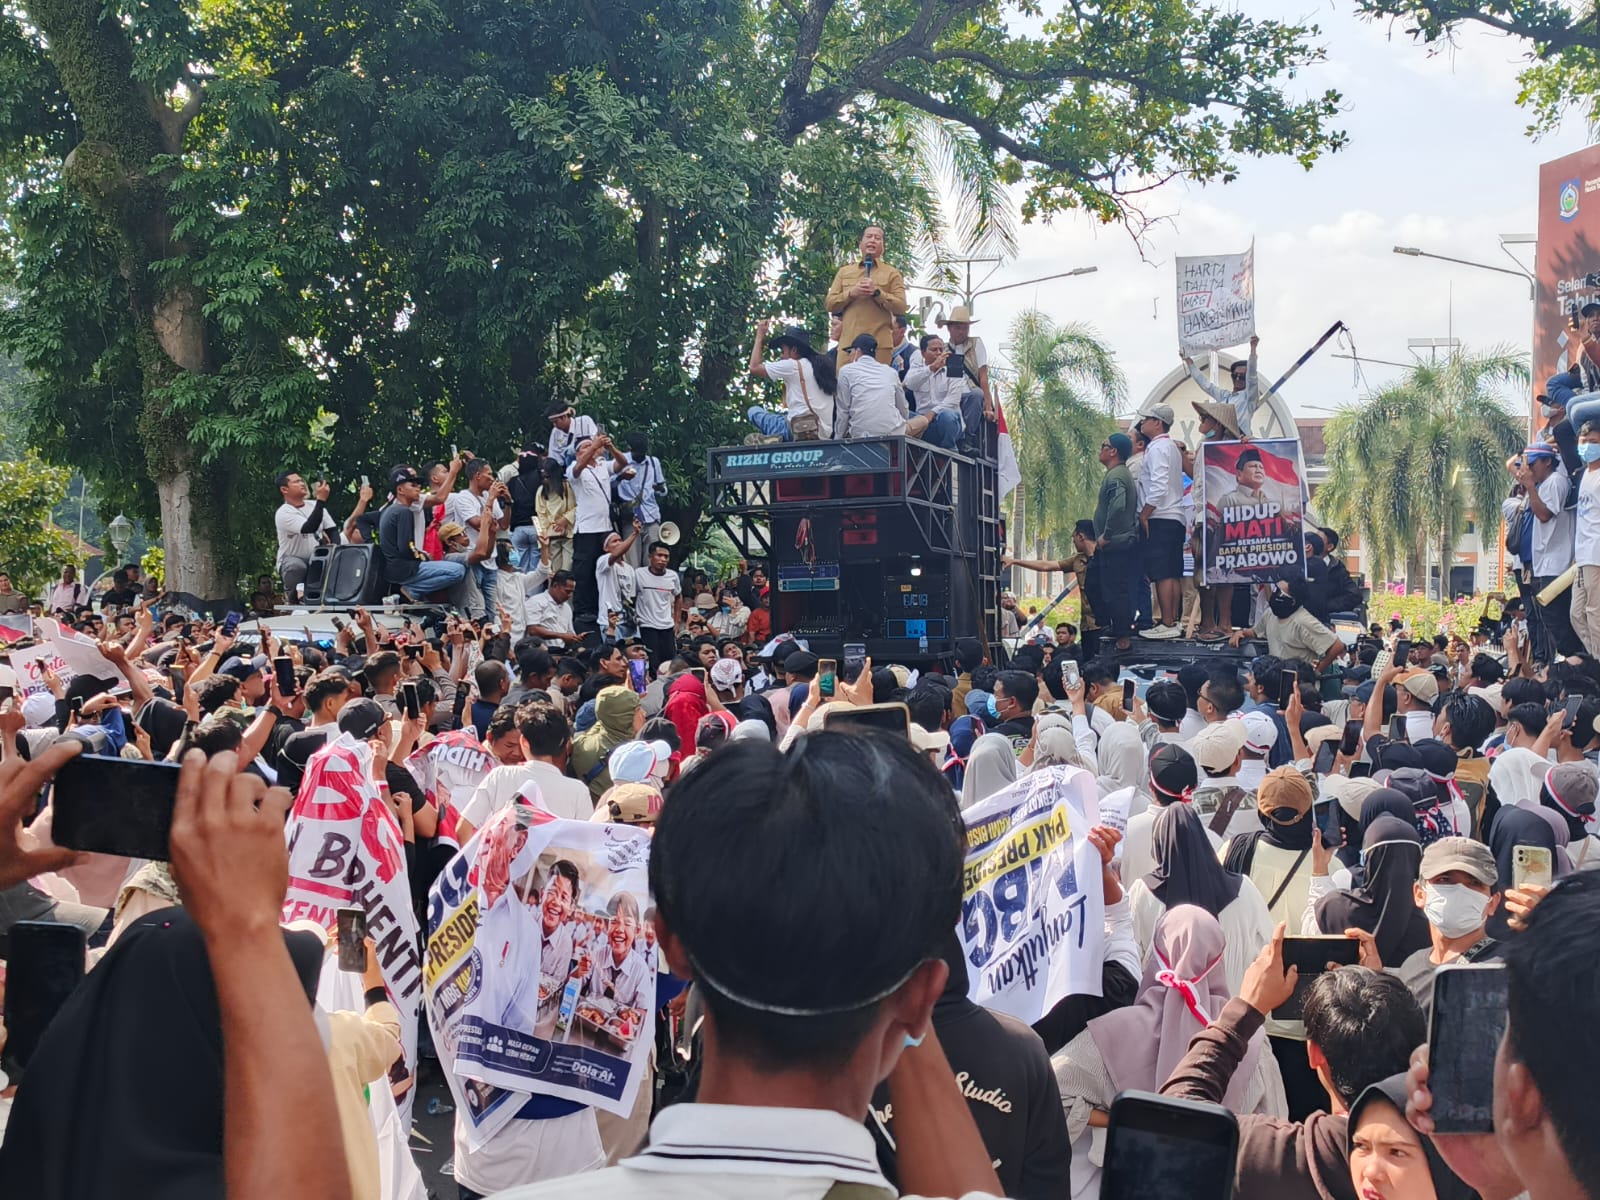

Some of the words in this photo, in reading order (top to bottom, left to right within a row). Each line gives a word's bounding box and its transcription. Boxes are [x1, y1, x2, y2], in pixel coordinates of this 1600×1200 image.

[1183, 263, 1226, 278] HARTA
[1183, 279, 1225, 291] TAHTA
[726, 453, 770, 467] RIZKI
[771, 449, 824, 464] GROUP
[1223, 502, 1281, 524] HIDUP
[1225, 516, 1283, 541] MATI
[1218, 546, 1249, 556] BAPAK
[1250, 542, 1294, 553] PRESIDEN
[1237, 537, 1272, 546] BERSAMA
[1215, 550, 1298, 570] PRABOWO
[29, 656, 68, 680] Cta
[966, 825, 989, 848] BISA
[988, 815, 1012, 840] KAMI
[1032, 812, 1067, 853] PAK
[963, 832, 1031, 892] PRESIDE
[280, 899, 338, 929] KENY
[427, 898, 486, 977] PRESIDE
[987, 894, 1088, 994] Lanjutkan
[440, 981, 462, 1010] MBG
[507, 1039, 522, 1049] MASA
[571, 1061, 598, 1078] Dola
[955, 1071, 1013, 1113] Studio
